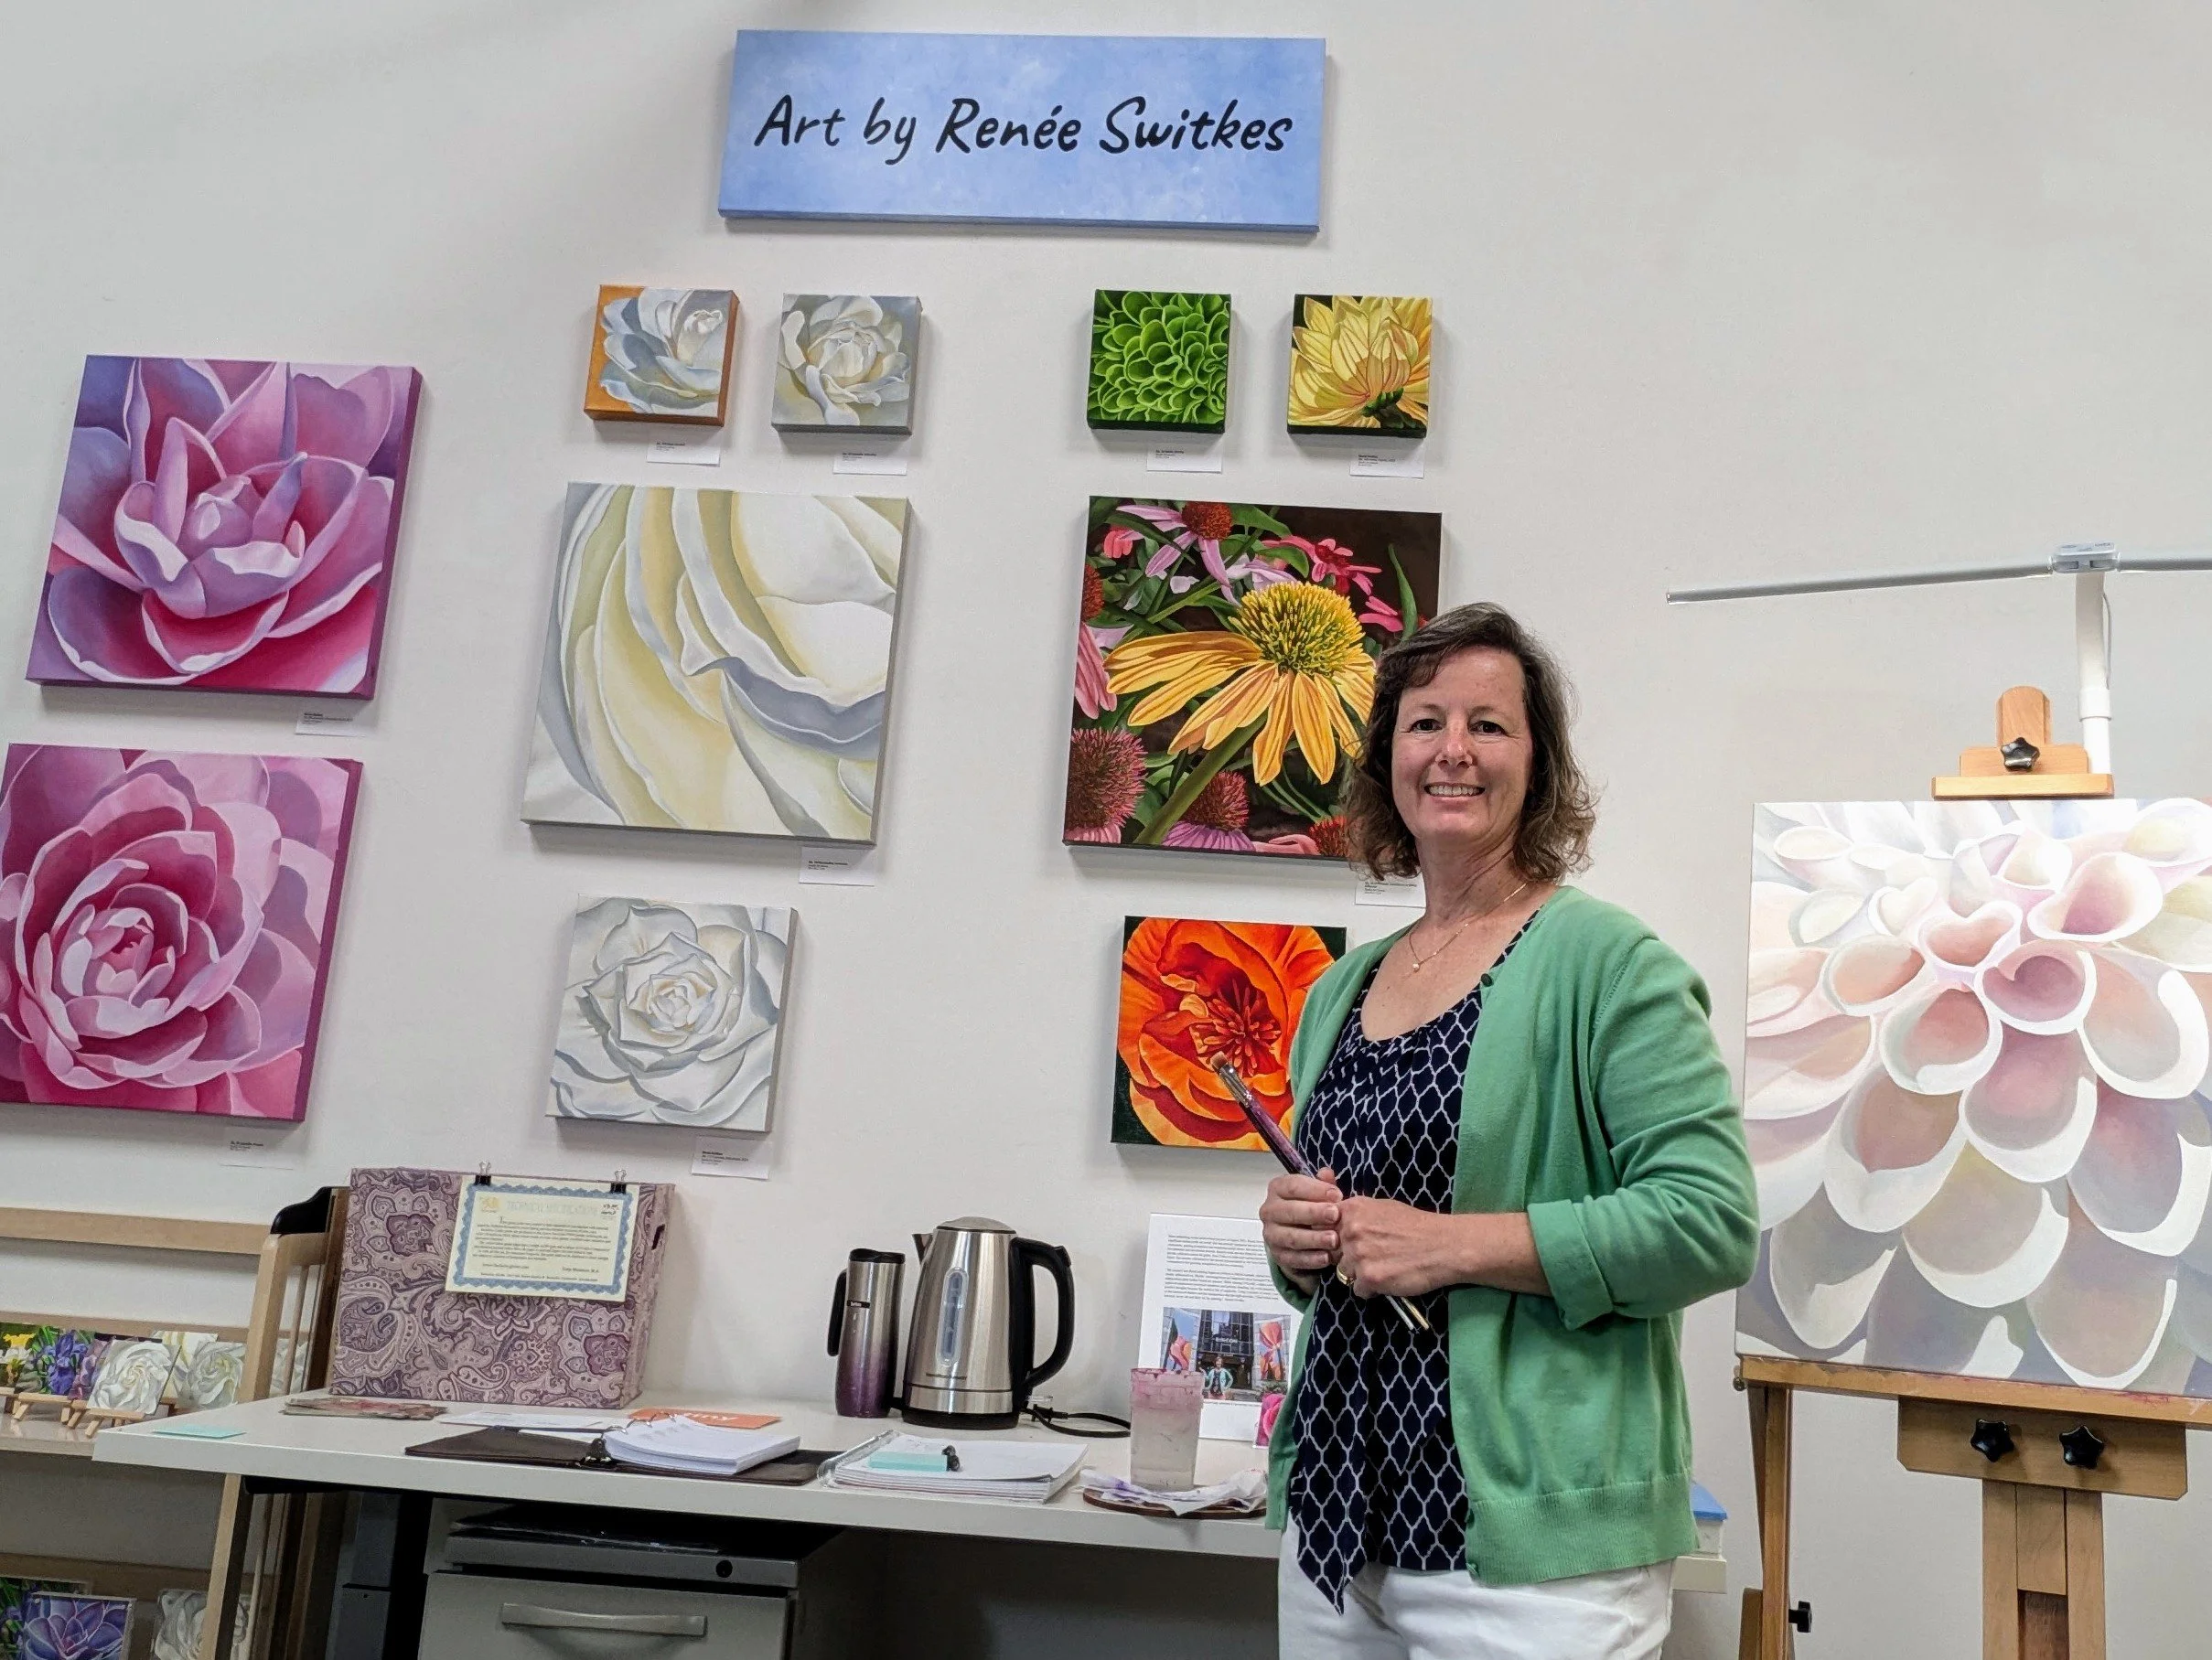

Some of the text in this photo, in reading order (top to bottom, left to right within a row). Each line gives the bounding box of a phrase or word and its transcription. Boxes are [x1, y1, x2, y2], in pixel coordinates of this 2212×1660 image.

[753, 94, 1294, 166] Art by Renée Switkes
